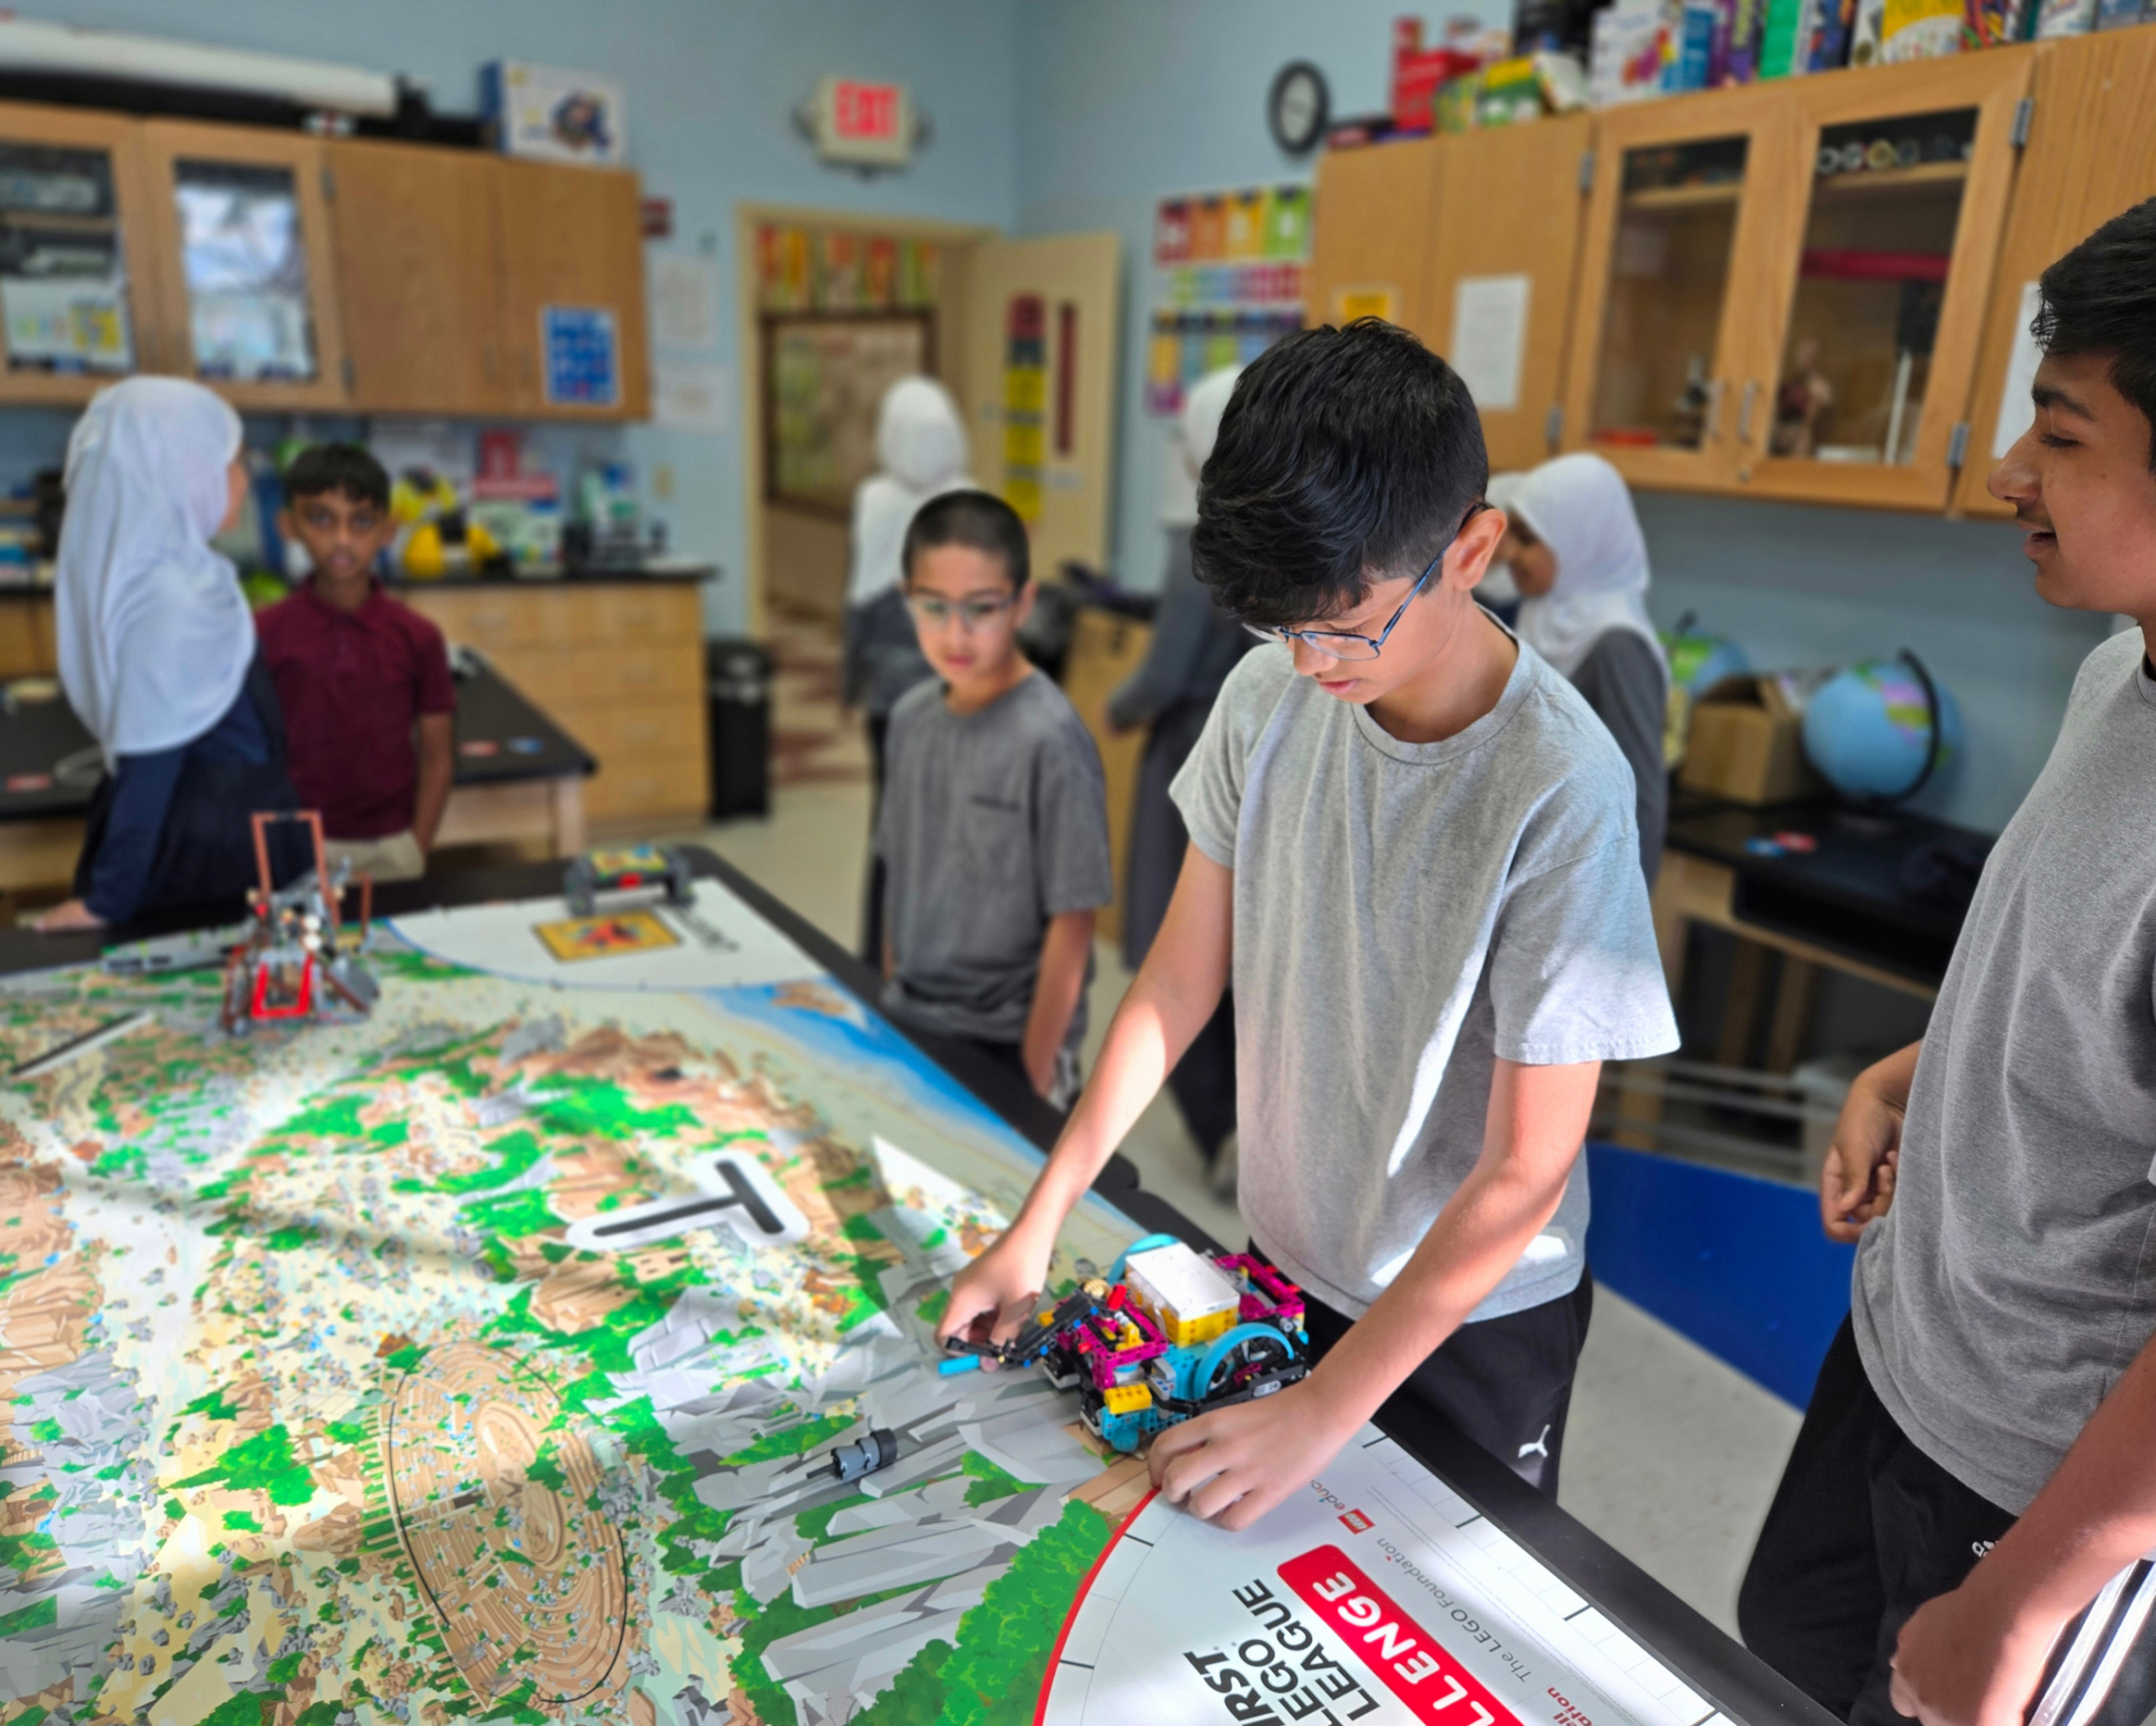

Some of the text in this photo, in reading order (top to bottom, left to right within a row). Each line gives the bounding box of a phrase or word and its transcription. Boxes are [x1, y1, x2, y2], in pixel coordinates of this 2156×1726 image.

[836, 81, 898, 138] EXIT
[1310, 1480, 1346, 1510] educ
[1376, 1537, 1454, 1609] Foundation
[1231, 1578, 1380, 1722] LEAGUE
[1312, 1571, 1496, 1726] LLENGE
[1450, 1608, 1502, 1653] LEGO
[1182, 1650, 1286, 1726] IRST
[1501, 1651, 1532, 1683] The
[1546, 1686, 1598, 1726] ation
